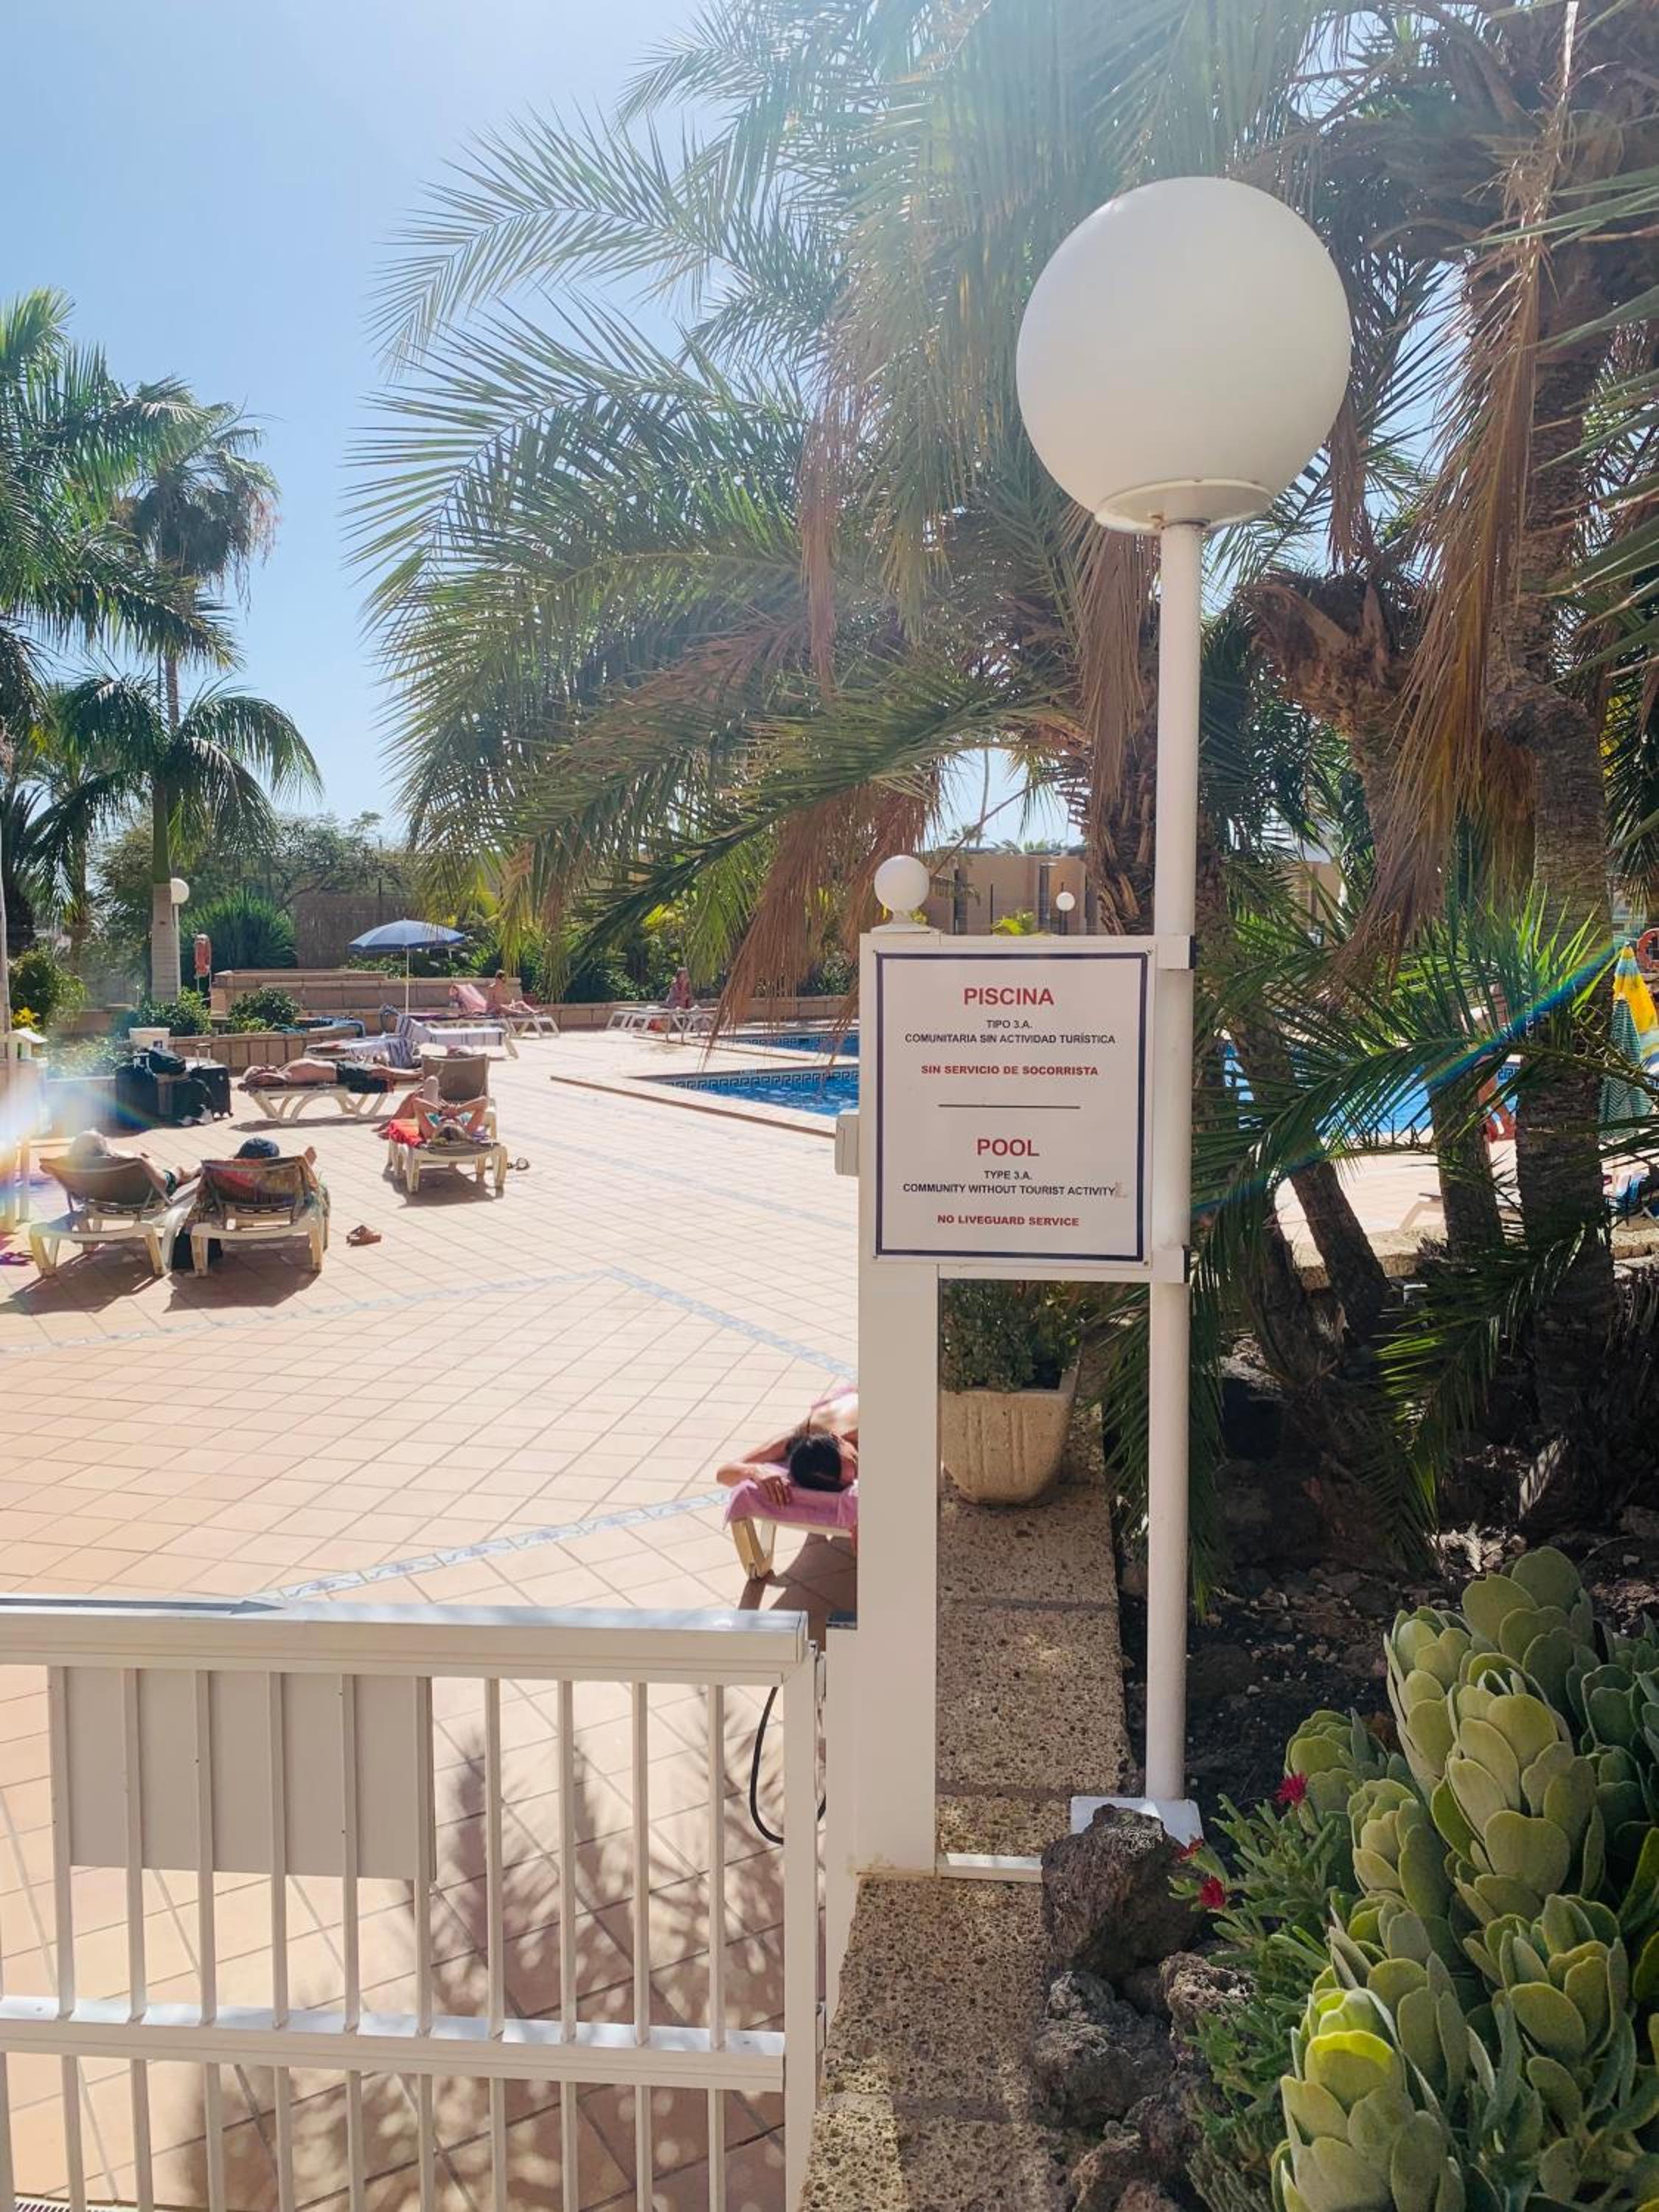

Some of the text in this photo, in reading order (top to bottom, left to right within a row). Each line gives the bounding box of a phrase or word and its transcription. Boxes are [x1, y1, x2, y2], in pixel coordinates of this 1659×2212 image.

[964, 987, 1054, 1005] PISCINA
[986, 1020, 1033, 1029] TIPO 3.A.
[905, 1032, 1116, 1044] COMUNITARIA SIN ACTIVIDAD TURÍSTICA
[921, 1065, 1099, 1076] SIN SERVICIO DE SOCORRISTA
[977, 1138, 1040, 1157] POOL
[984, 1170, 1032, 1180] TYPE 3.A.
[903, 1183, 1115, 1196] COMMUNITY WITHOUT TOURIST ACTIVITY
[937, 1214, 1079, 1227] NO LIVEGUARD SERVICE
